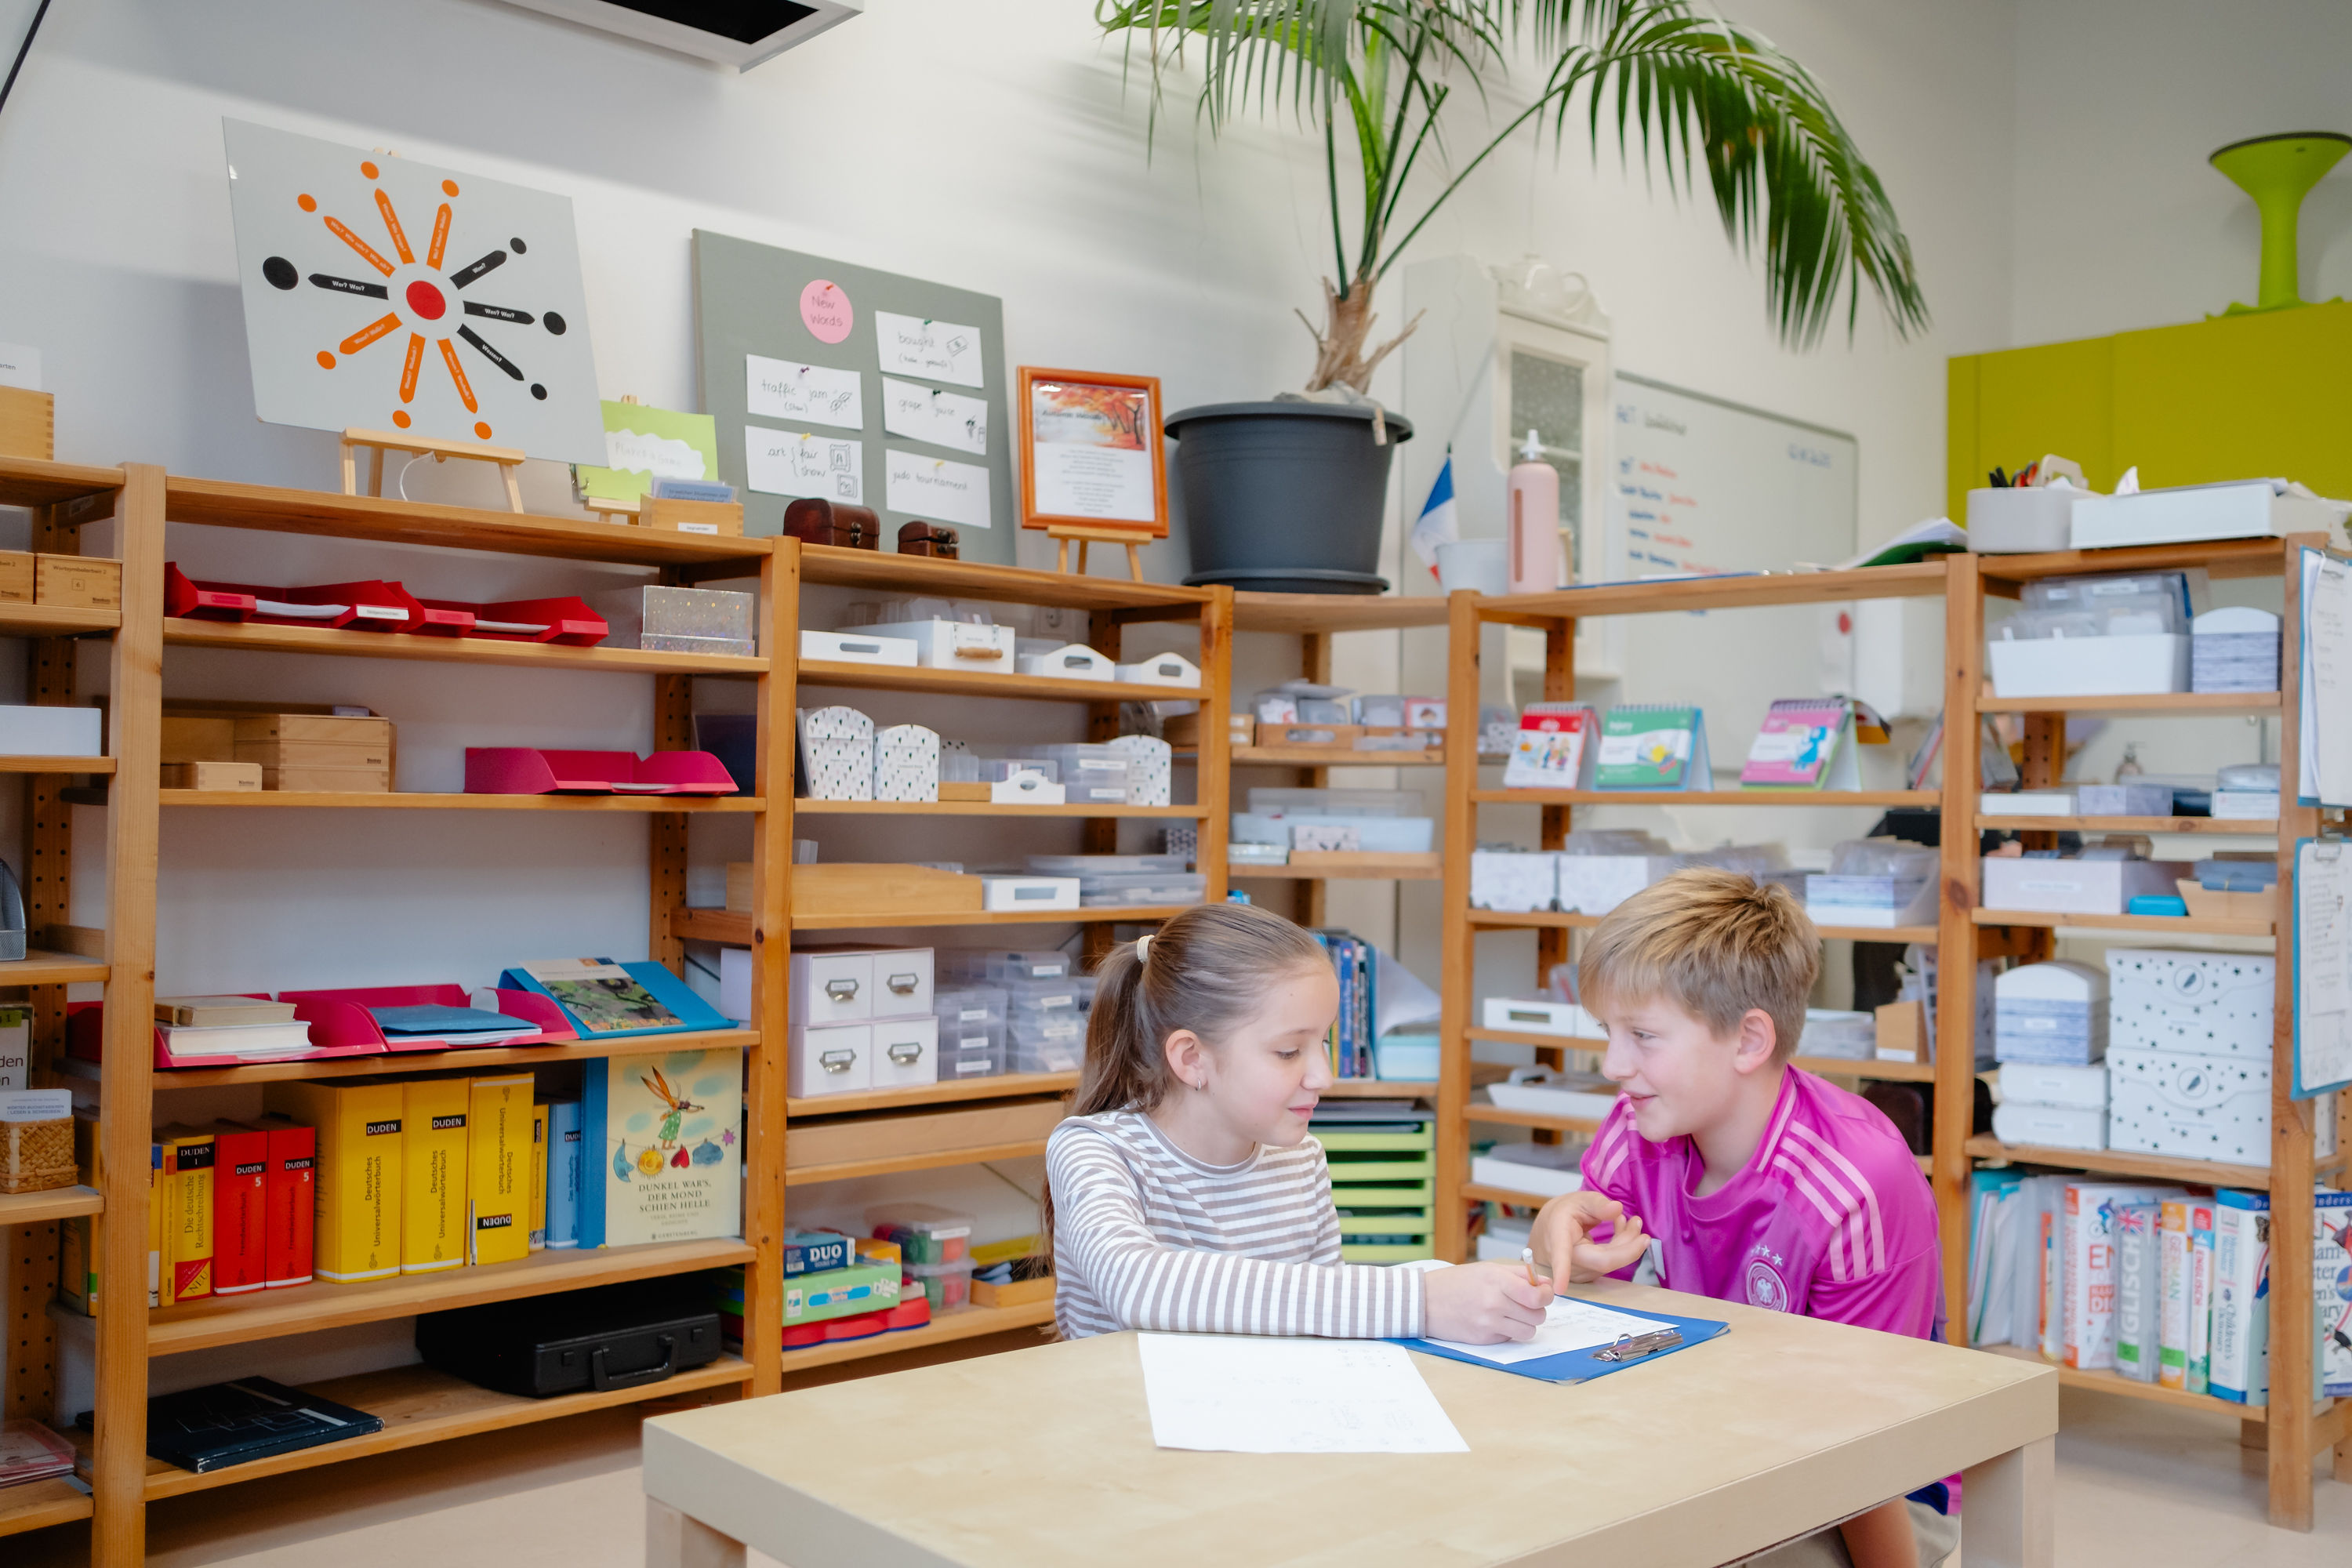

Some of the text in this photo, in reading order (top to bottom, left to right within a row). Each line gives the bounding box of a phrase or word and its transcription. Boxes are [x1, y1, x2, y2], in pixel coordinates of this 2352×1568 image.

[811, 295, 835, 310] New
[811, 314, 843, 328] Words
[898, 331, 934, 352] bought
[761, 379, 828, 401] traffic jam
[768, 447, 786, 456] art
[916, 473, 967, 491] tournament
[367, 1122, 397, 1134] DUDEN
[433, 1117, 462, 1129] DUDEN
[180, 1146, 210, 1156] DUDEN
[237, 1165, 262, 1174] DUDEN
[285, 1160, 310, 1170] DUDEN
[255, 1177, 261, 1187] 5
[303, 1172, 309, 1182] 5
[639, 1181, 679, 1192] DUNKEL
[648, 1190, 702, 1201] DER MOND
[2315, 1195, 2352, 1207] nders
[184, 1176, 194, 1234] Die deutsche
[640, 1200, 710, 1212] SCHIEN HELLE
[195, 1174, 206, 1249] Rechtschreibung
[483, 1216, 511, 1227] DUDEN
[809, 1244, 842, 1262] DUO
[2314, 1266, 2337, 1279] ter
[188, 1270, 209, 1294] NEU
